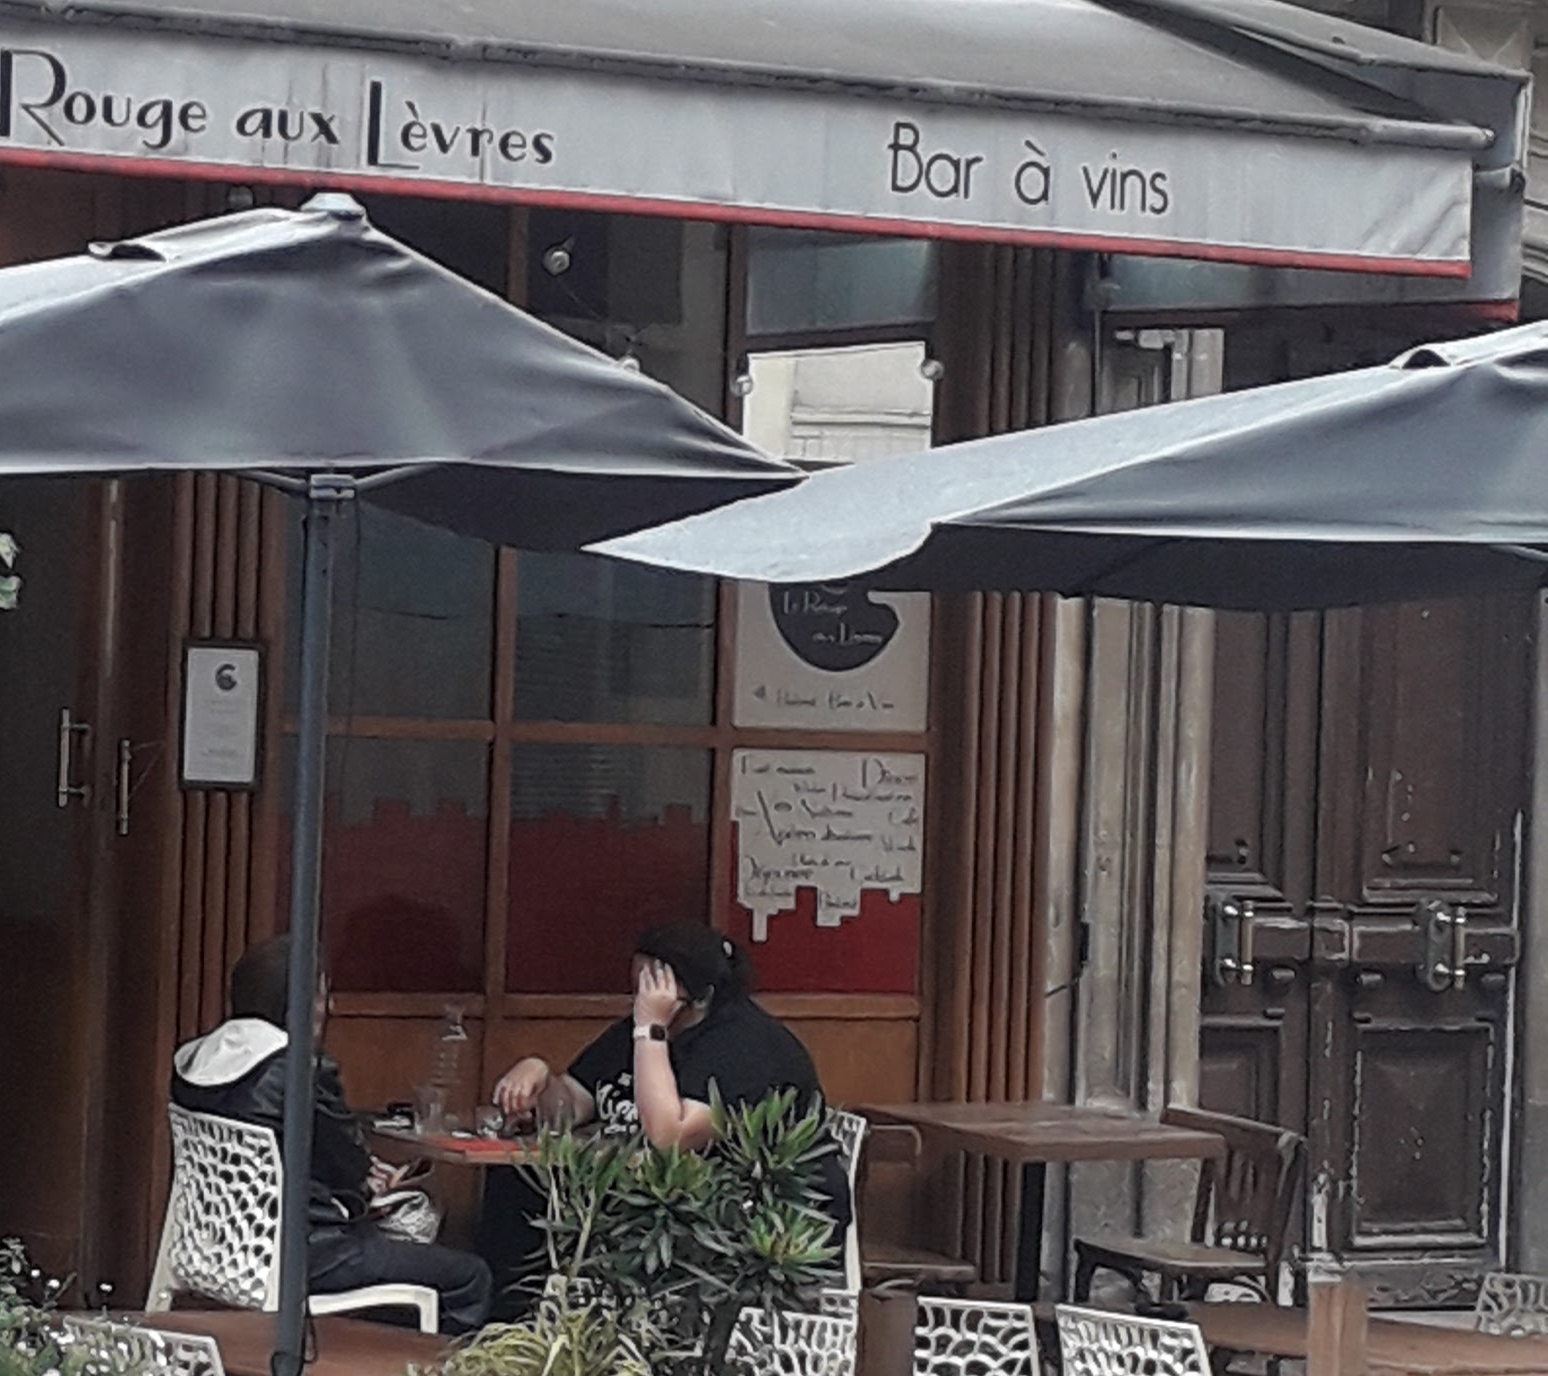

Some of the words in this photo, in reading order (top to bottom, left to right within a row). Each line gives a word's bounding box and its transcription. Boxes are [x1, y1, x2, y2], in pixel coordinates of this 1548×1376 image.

[235, 104, 341, 147] aux
[366, 79, 556, 170] Lèvres
[887, 121, 985, 200] Bar
[1013, 139, 1051, 206] à
[1082, 152, 1171, 216] vins
